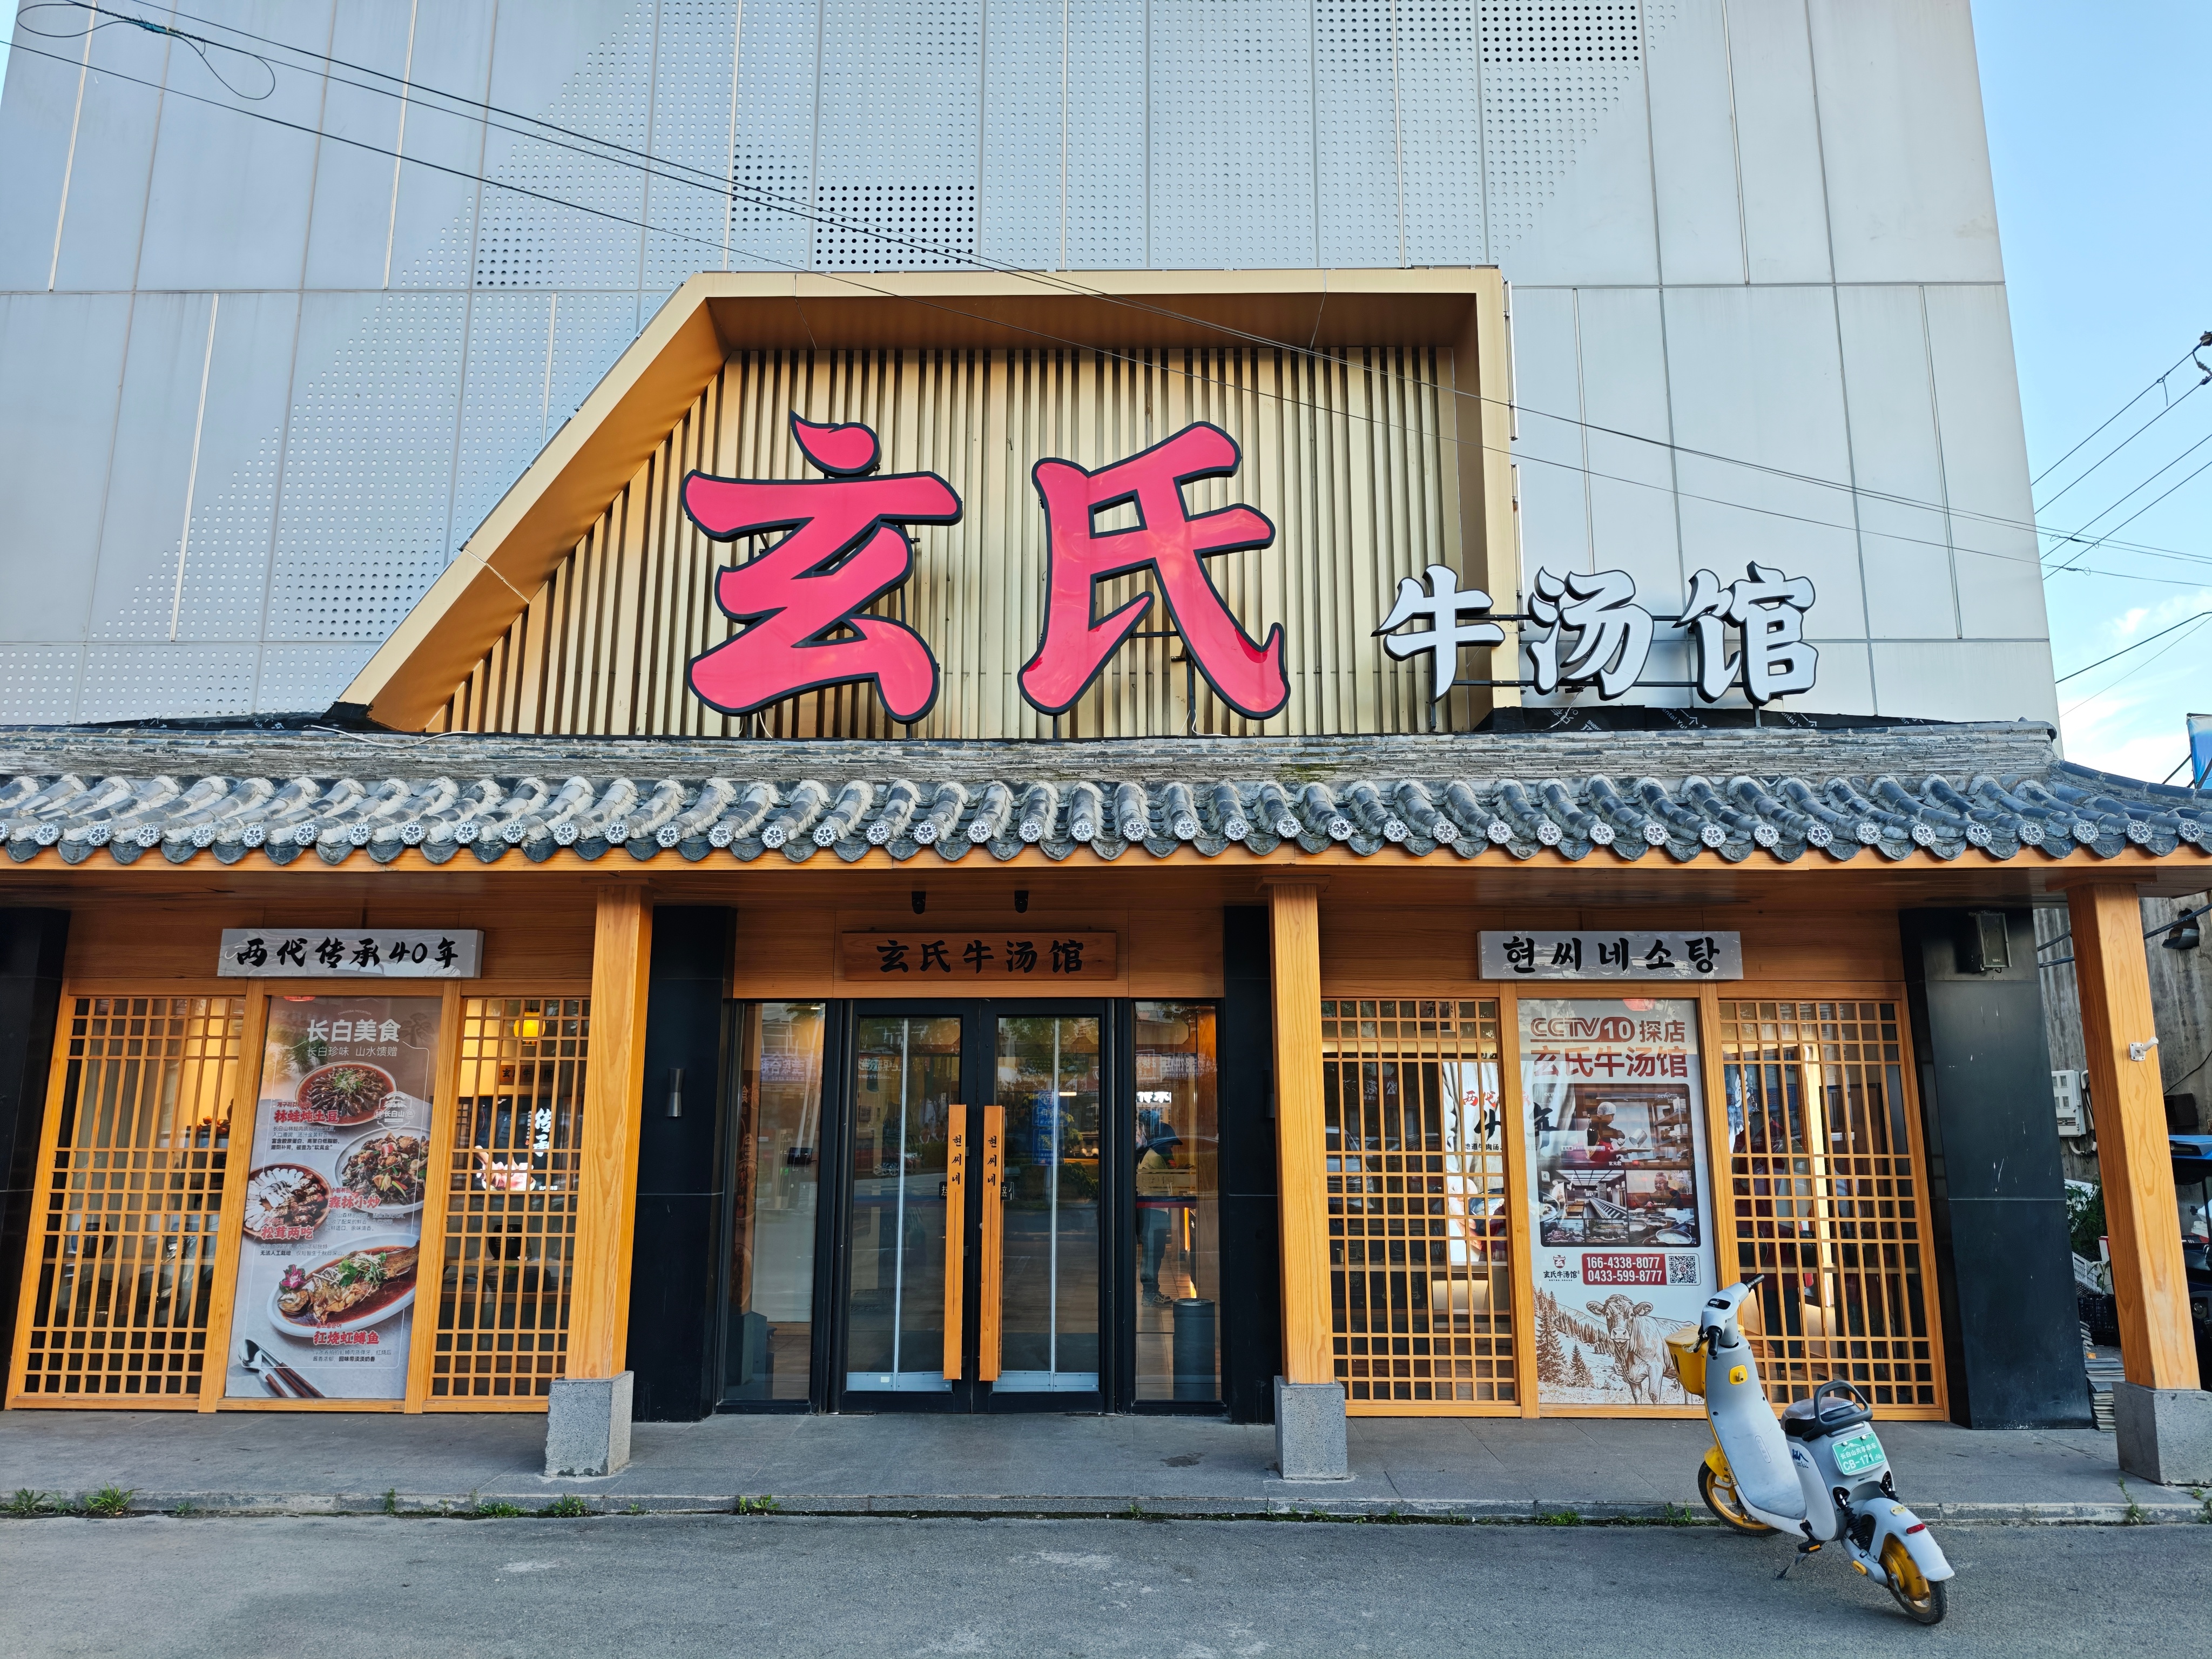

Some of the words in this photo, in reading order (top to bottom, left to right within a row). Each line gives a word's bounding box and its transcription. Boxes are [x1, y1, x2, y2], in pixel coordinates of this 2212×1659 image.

[1371, 561, 1819, 705] 牛汤馆
[237, 936, 458, 969] 两代传承40年
[876, 939, 1084, 974] 玄氏牛汤馆
[1503, 936, 1721, 973] 현씨네소탕
[307, 1019, 401, 1042] 长白美食
[1639, 1020, 1685, 1043] 探店
[307, 1046, 349, 1056] 长白珍味
[355, 1046, 397, 1056] 山水馈赠
[1530, 1046, 1688, 1077] 玄氏牛汤馆
[274, 1109, 340, 1123] 林蛙炖土豆
[952, 1135, 962, 1185] 현씨네
[987, 1136, 997, 1186] 현씨네
[328, 1195, 381, 1209] 森林小炒
[261, 1225, 314, 1239] 松茸两吃
[1587, 1257, 1660, 1269] 166-4338-8077
[1543, 1270, 1577, 1279] 玄氏牛汤馆
[1588, 1270, 1662, 1282] 0433-599-8777
[313, 1331, 380, 1345] 红烧虹鳟鱼
[1840, 1442, 1877, 1460] 长白山共享单车
[1843, 1453, 1874, 1471] CB-171
